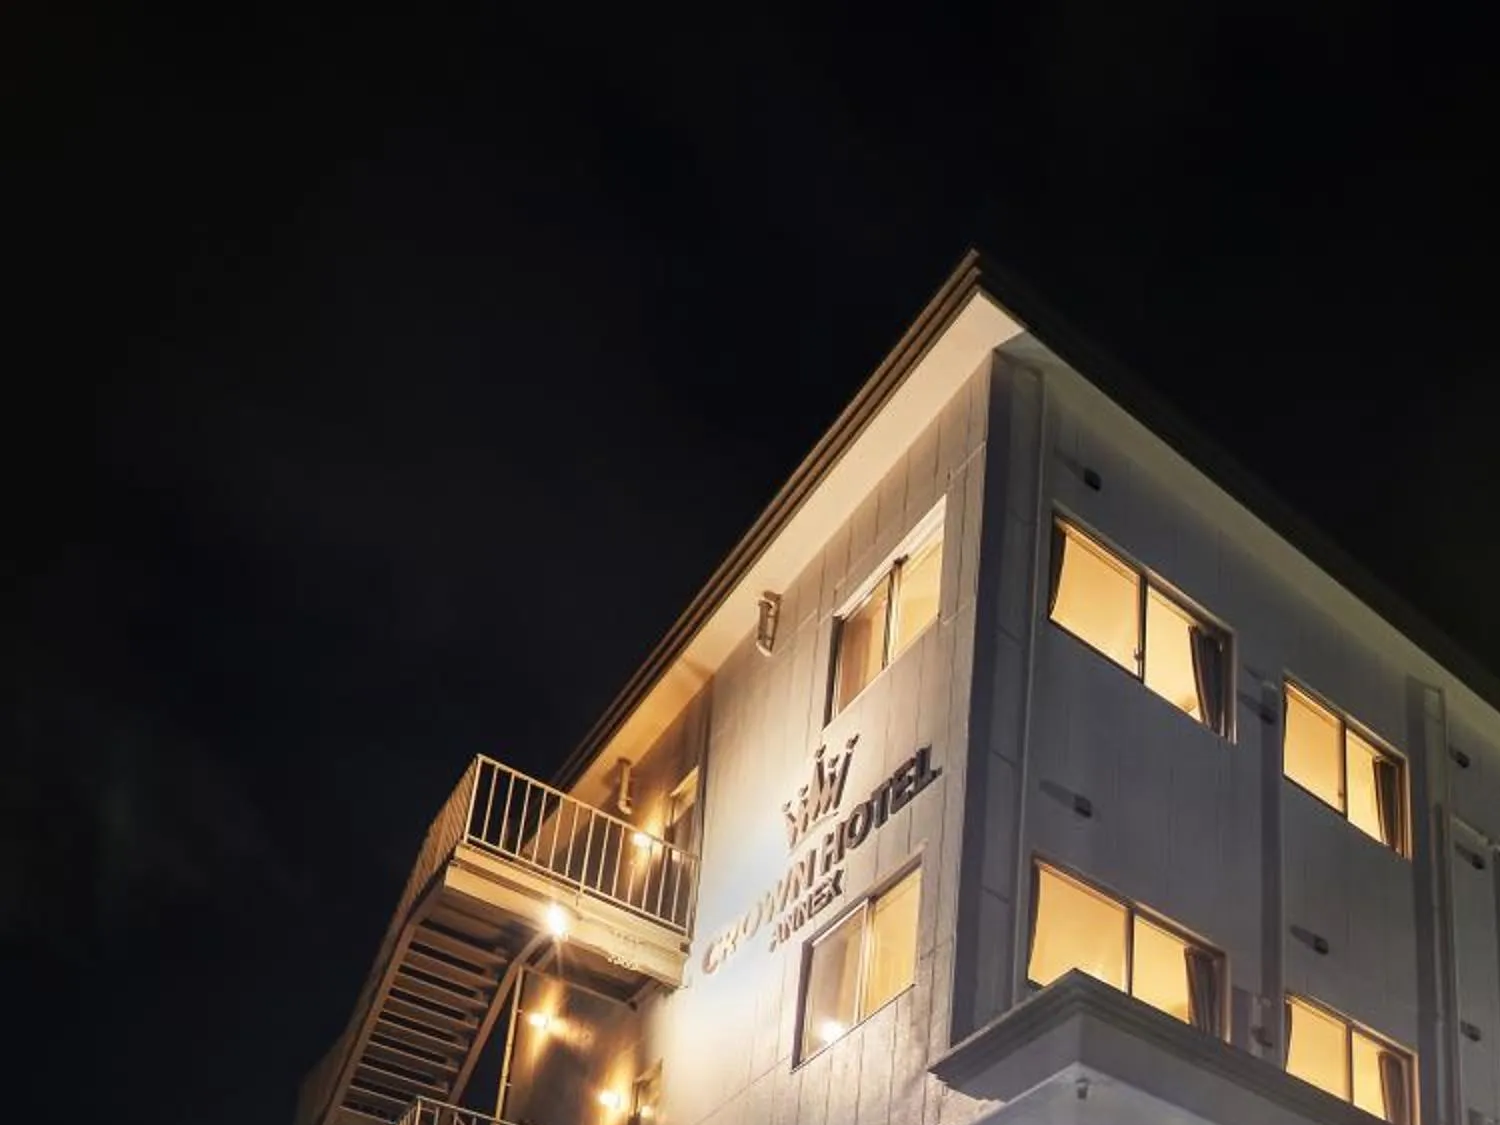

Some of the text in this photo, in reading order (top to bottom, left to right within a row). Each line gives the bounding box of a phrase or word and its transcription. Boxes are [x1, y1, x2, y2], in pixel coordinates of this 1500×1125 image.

[702, 743, 943, 974] CROWN HOTEL
[767, 867, 845, 954] ANNEX
